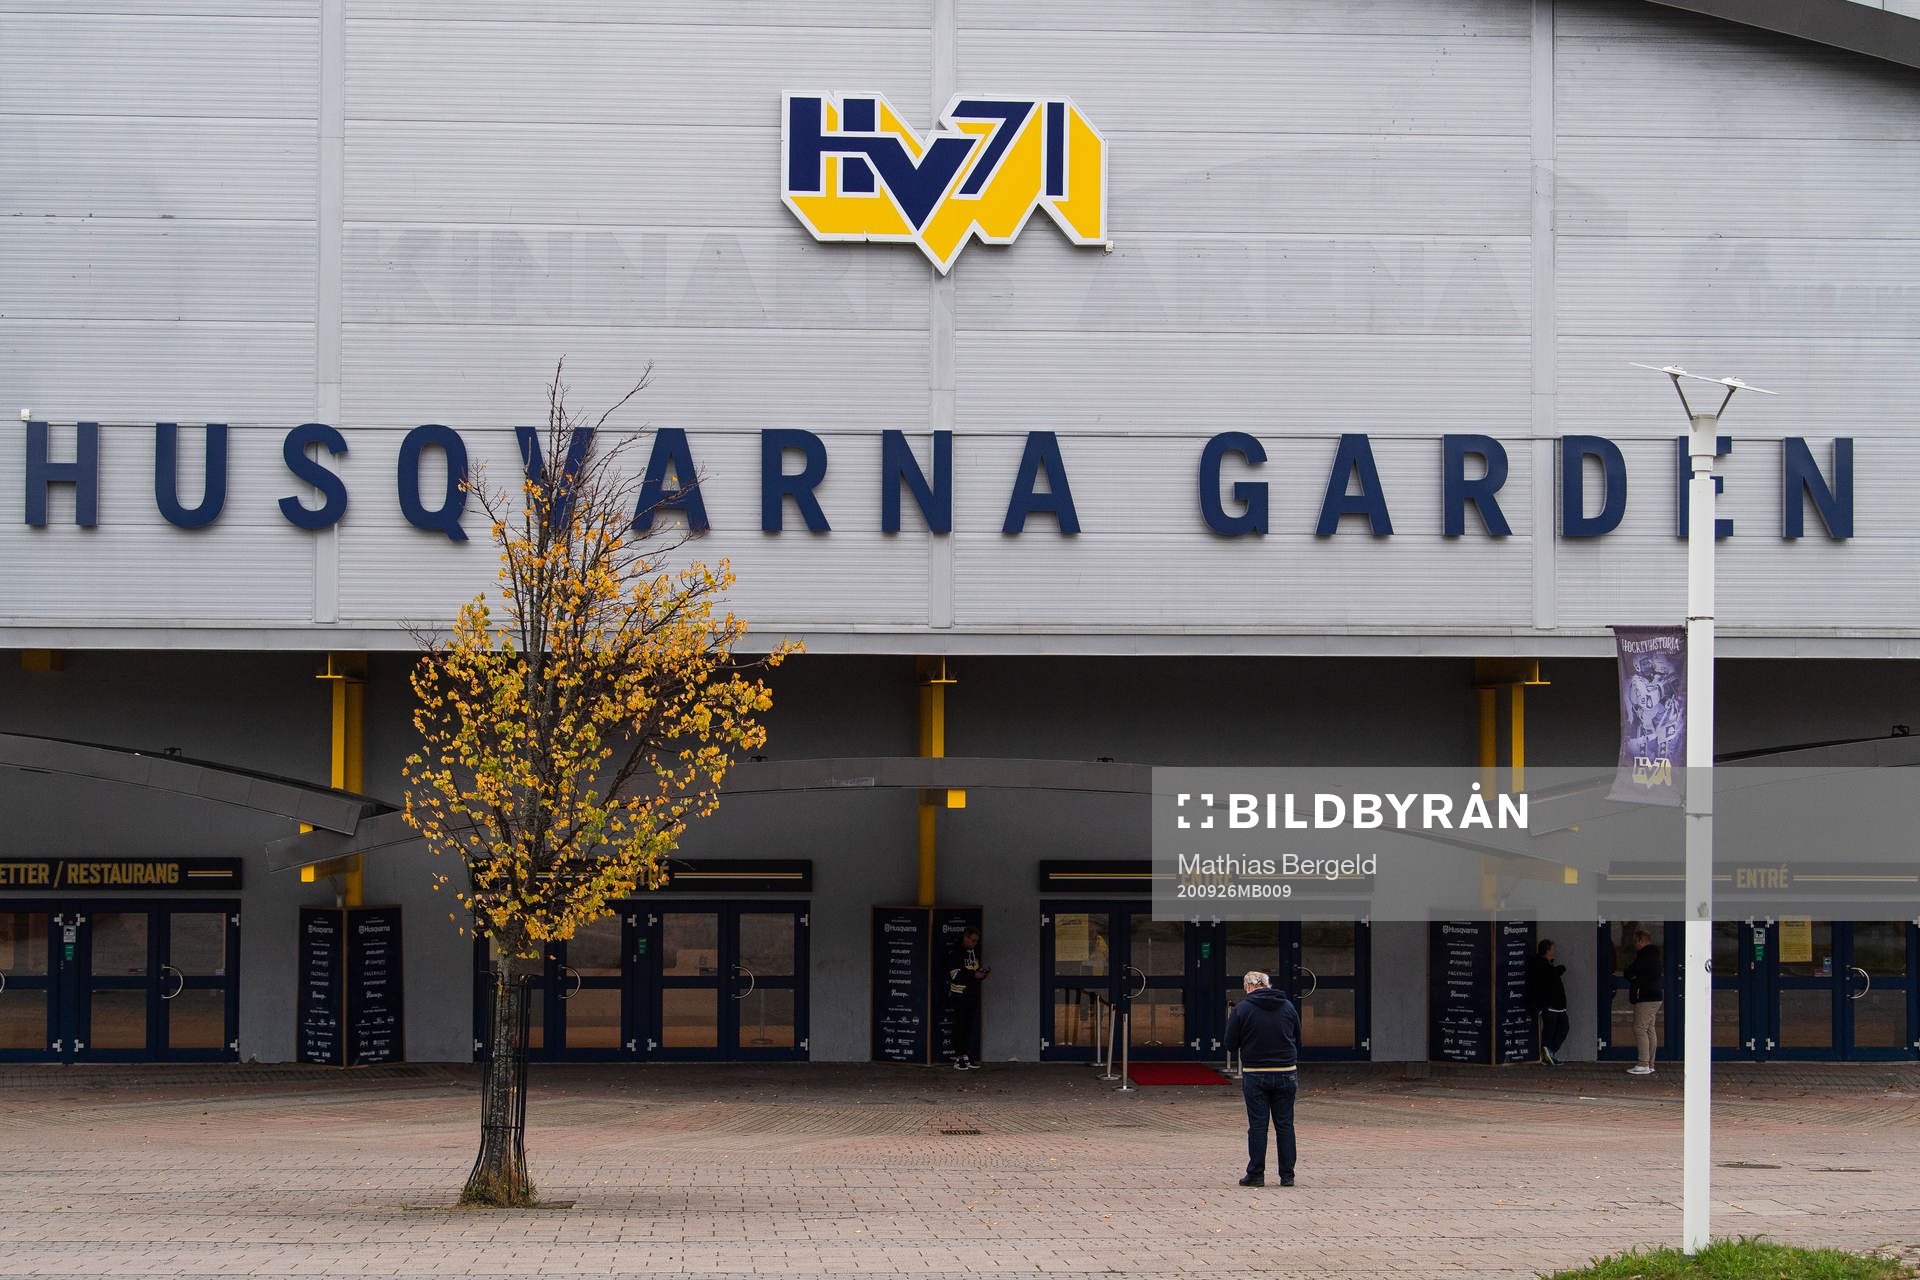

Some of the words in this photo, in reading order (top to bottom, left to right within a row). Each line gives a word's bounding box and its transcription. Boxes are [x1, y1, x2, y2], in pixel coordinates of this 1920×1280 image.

[785, 92, 1085, 258] HV71
[25, 421, 1082, 541] HUSQVARNA
[67, 863, 179, 884] RESTAURANG
[1736, 862, 1789, 889] ENTRÉ
